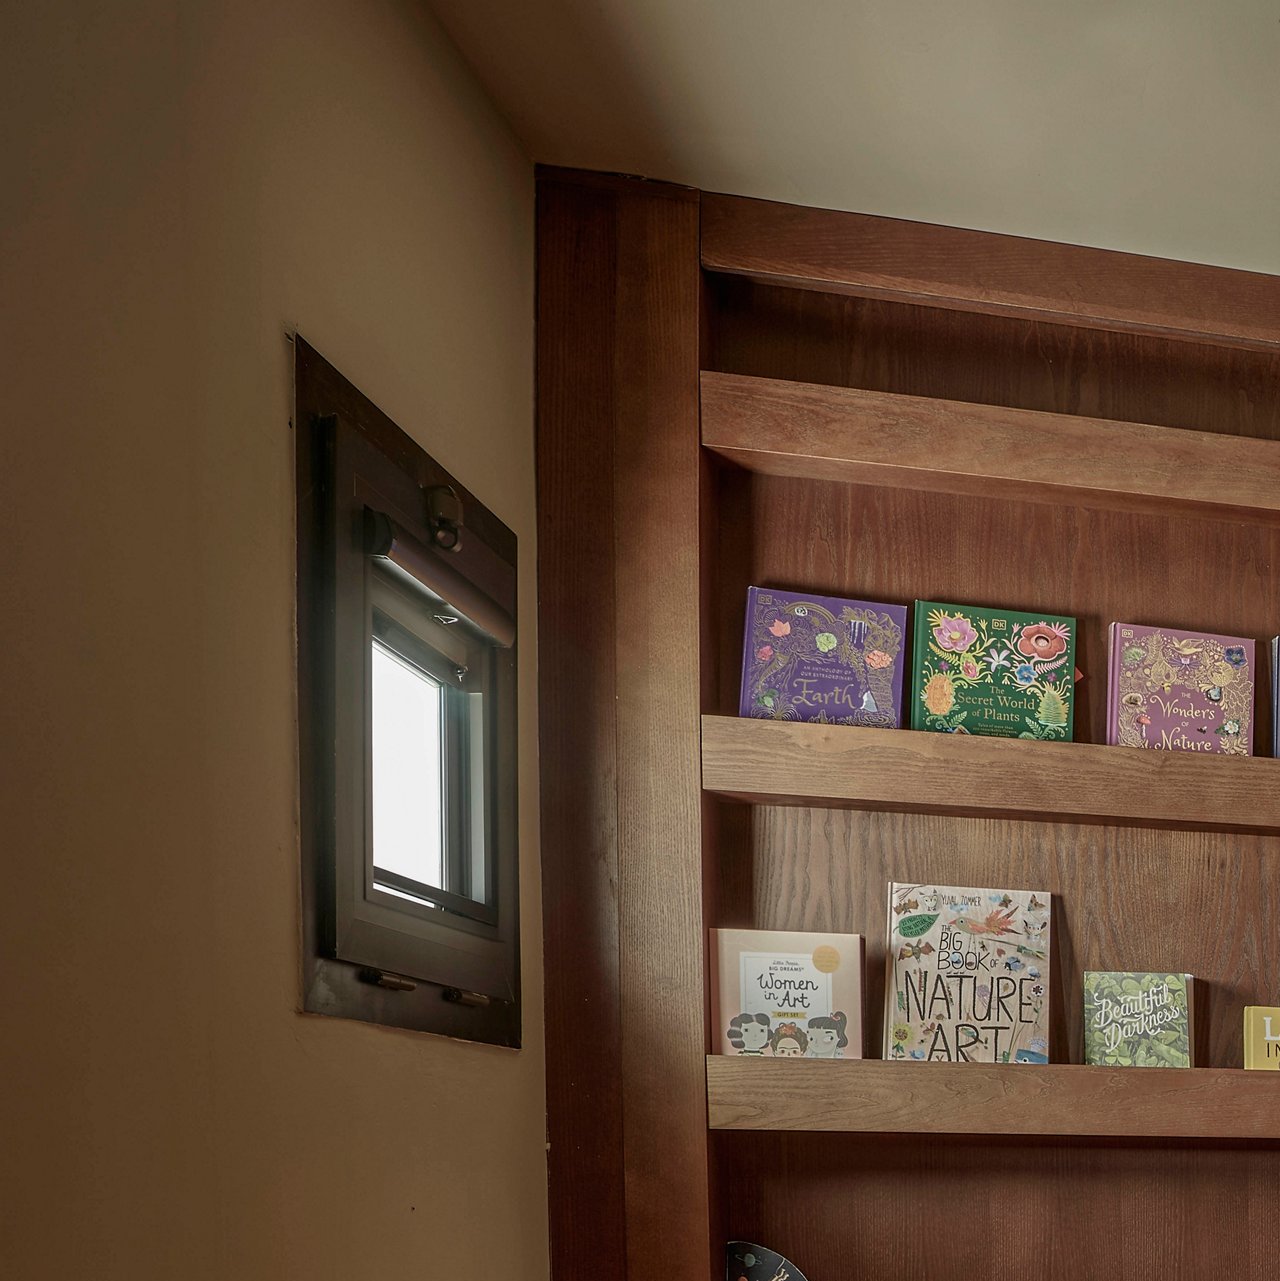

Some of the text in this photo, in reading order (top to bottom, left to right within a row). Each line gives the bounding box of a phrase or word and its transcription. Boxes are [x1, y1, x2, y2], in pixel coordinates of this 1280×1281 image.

[792, 678, 856, 709] Earth
[990, 686, 1004, 694] The
[958, 692, 1036, 710] Secret World
[1150, 695, 1215, 720] Wonders
[972, 708, 1020, 722] of Plants
[1155, 727, 1212, 751] Nature
[942, 896, 982, 906] YUVAL ZOMMER
[939, 932, 962, 951] BIG
[938, 950, 999, 971] BOOK OF
[757, 973, 818, 990] Women
[764, 991, 810, 1008] in Art
[905, 970, 1035, 1023] NATURE
[1094, 983, 1172, 1028] Beautiful
[1103, 1006, 1180, 1053] Darkness
[928, 1023, 1010, 1062] ART
